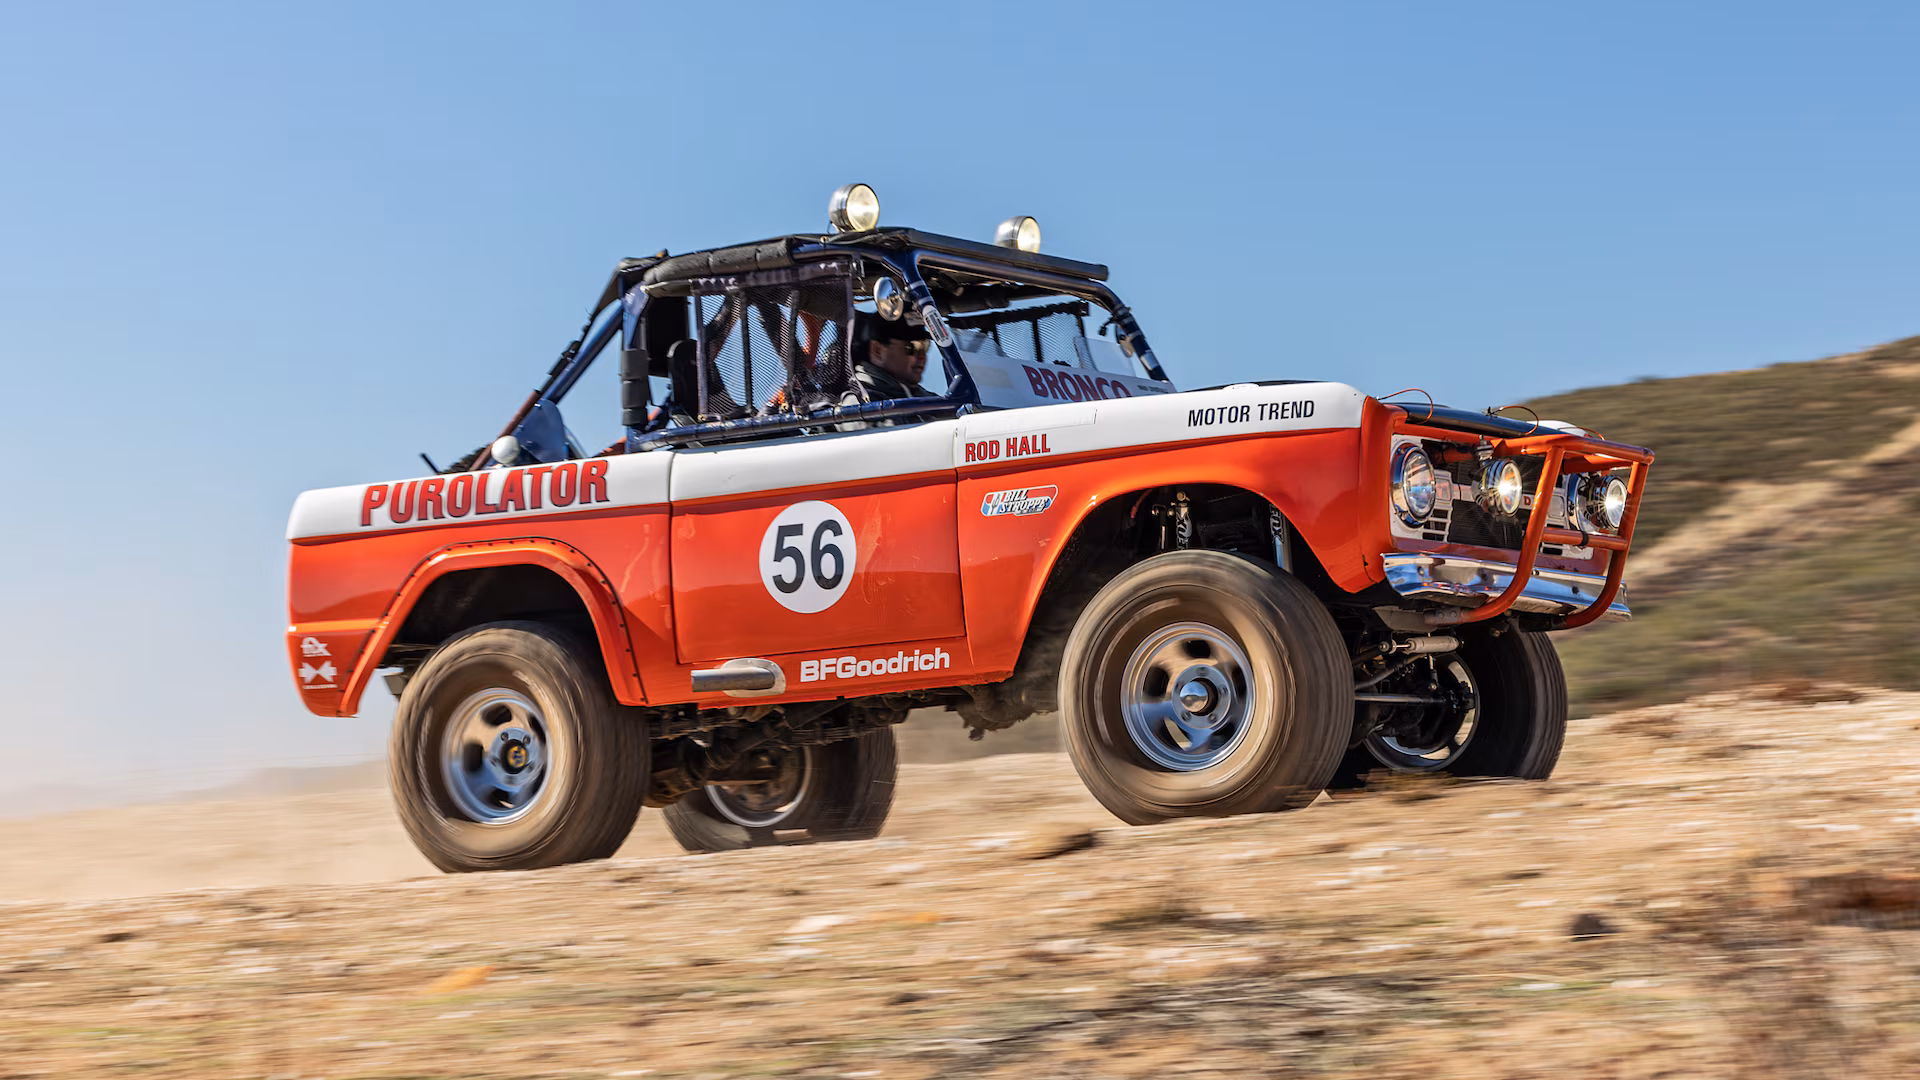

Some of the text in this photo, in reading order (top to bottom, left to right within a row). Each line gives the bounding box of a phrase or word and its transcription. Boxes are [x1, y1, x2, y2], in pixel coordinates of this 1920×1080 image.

[1021, 364, 1132, 402] BRONCO
[1188, 400, 1315, 427] MOTOR TREND
[965, 433, 1051, 463] ROD HALL
[360, 459, 610, 527] PUROLATOR
[1000, 498, 1048, 514] STROPPE
[1003, 490, 1029, 502] BILL
[772, 519, 845, 594] 56
[800, 647, 950, 683] BFGoodrich
